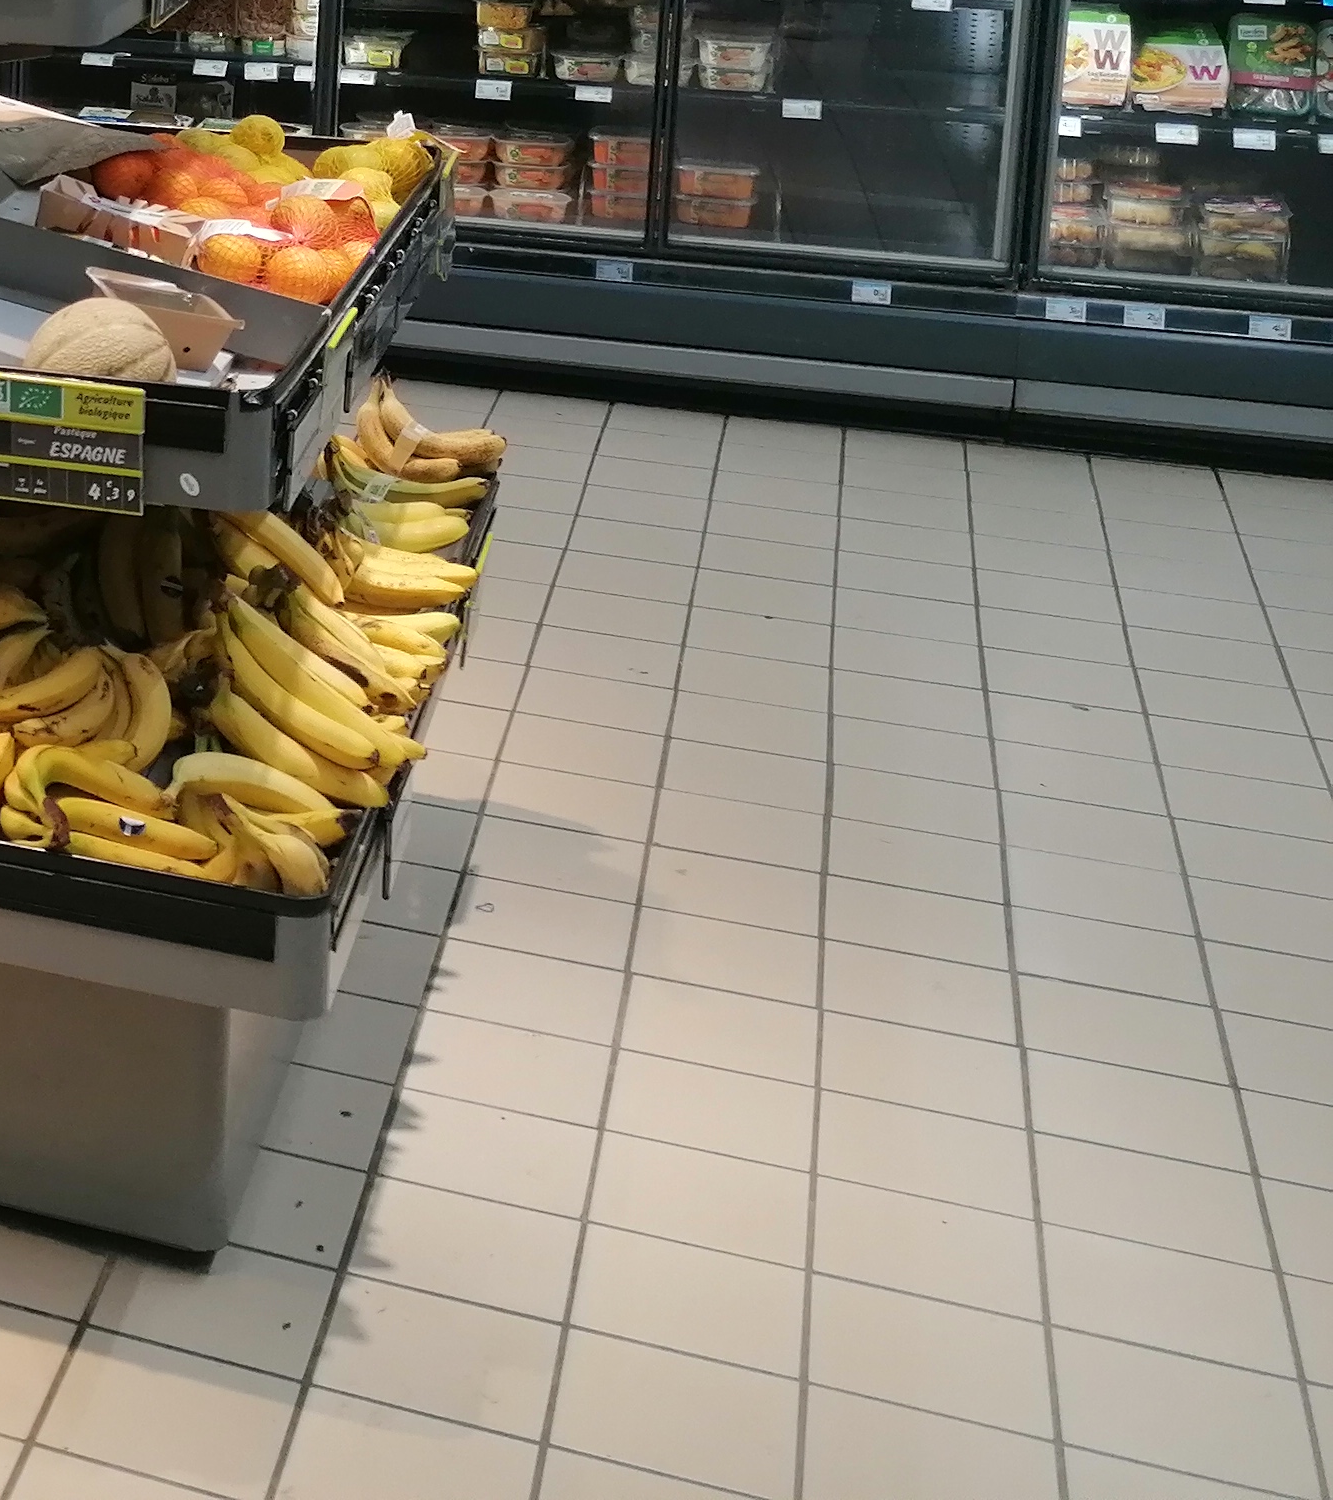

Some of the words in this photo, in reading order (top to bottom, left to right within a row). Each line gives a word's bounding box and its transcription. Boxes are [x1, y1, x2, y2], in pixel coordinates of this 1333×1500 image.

[76, 392, 135, 408] Agriculture
[78, 407, 131, 422] biologique
[49, 441, 127, 465] ESPAGNE
